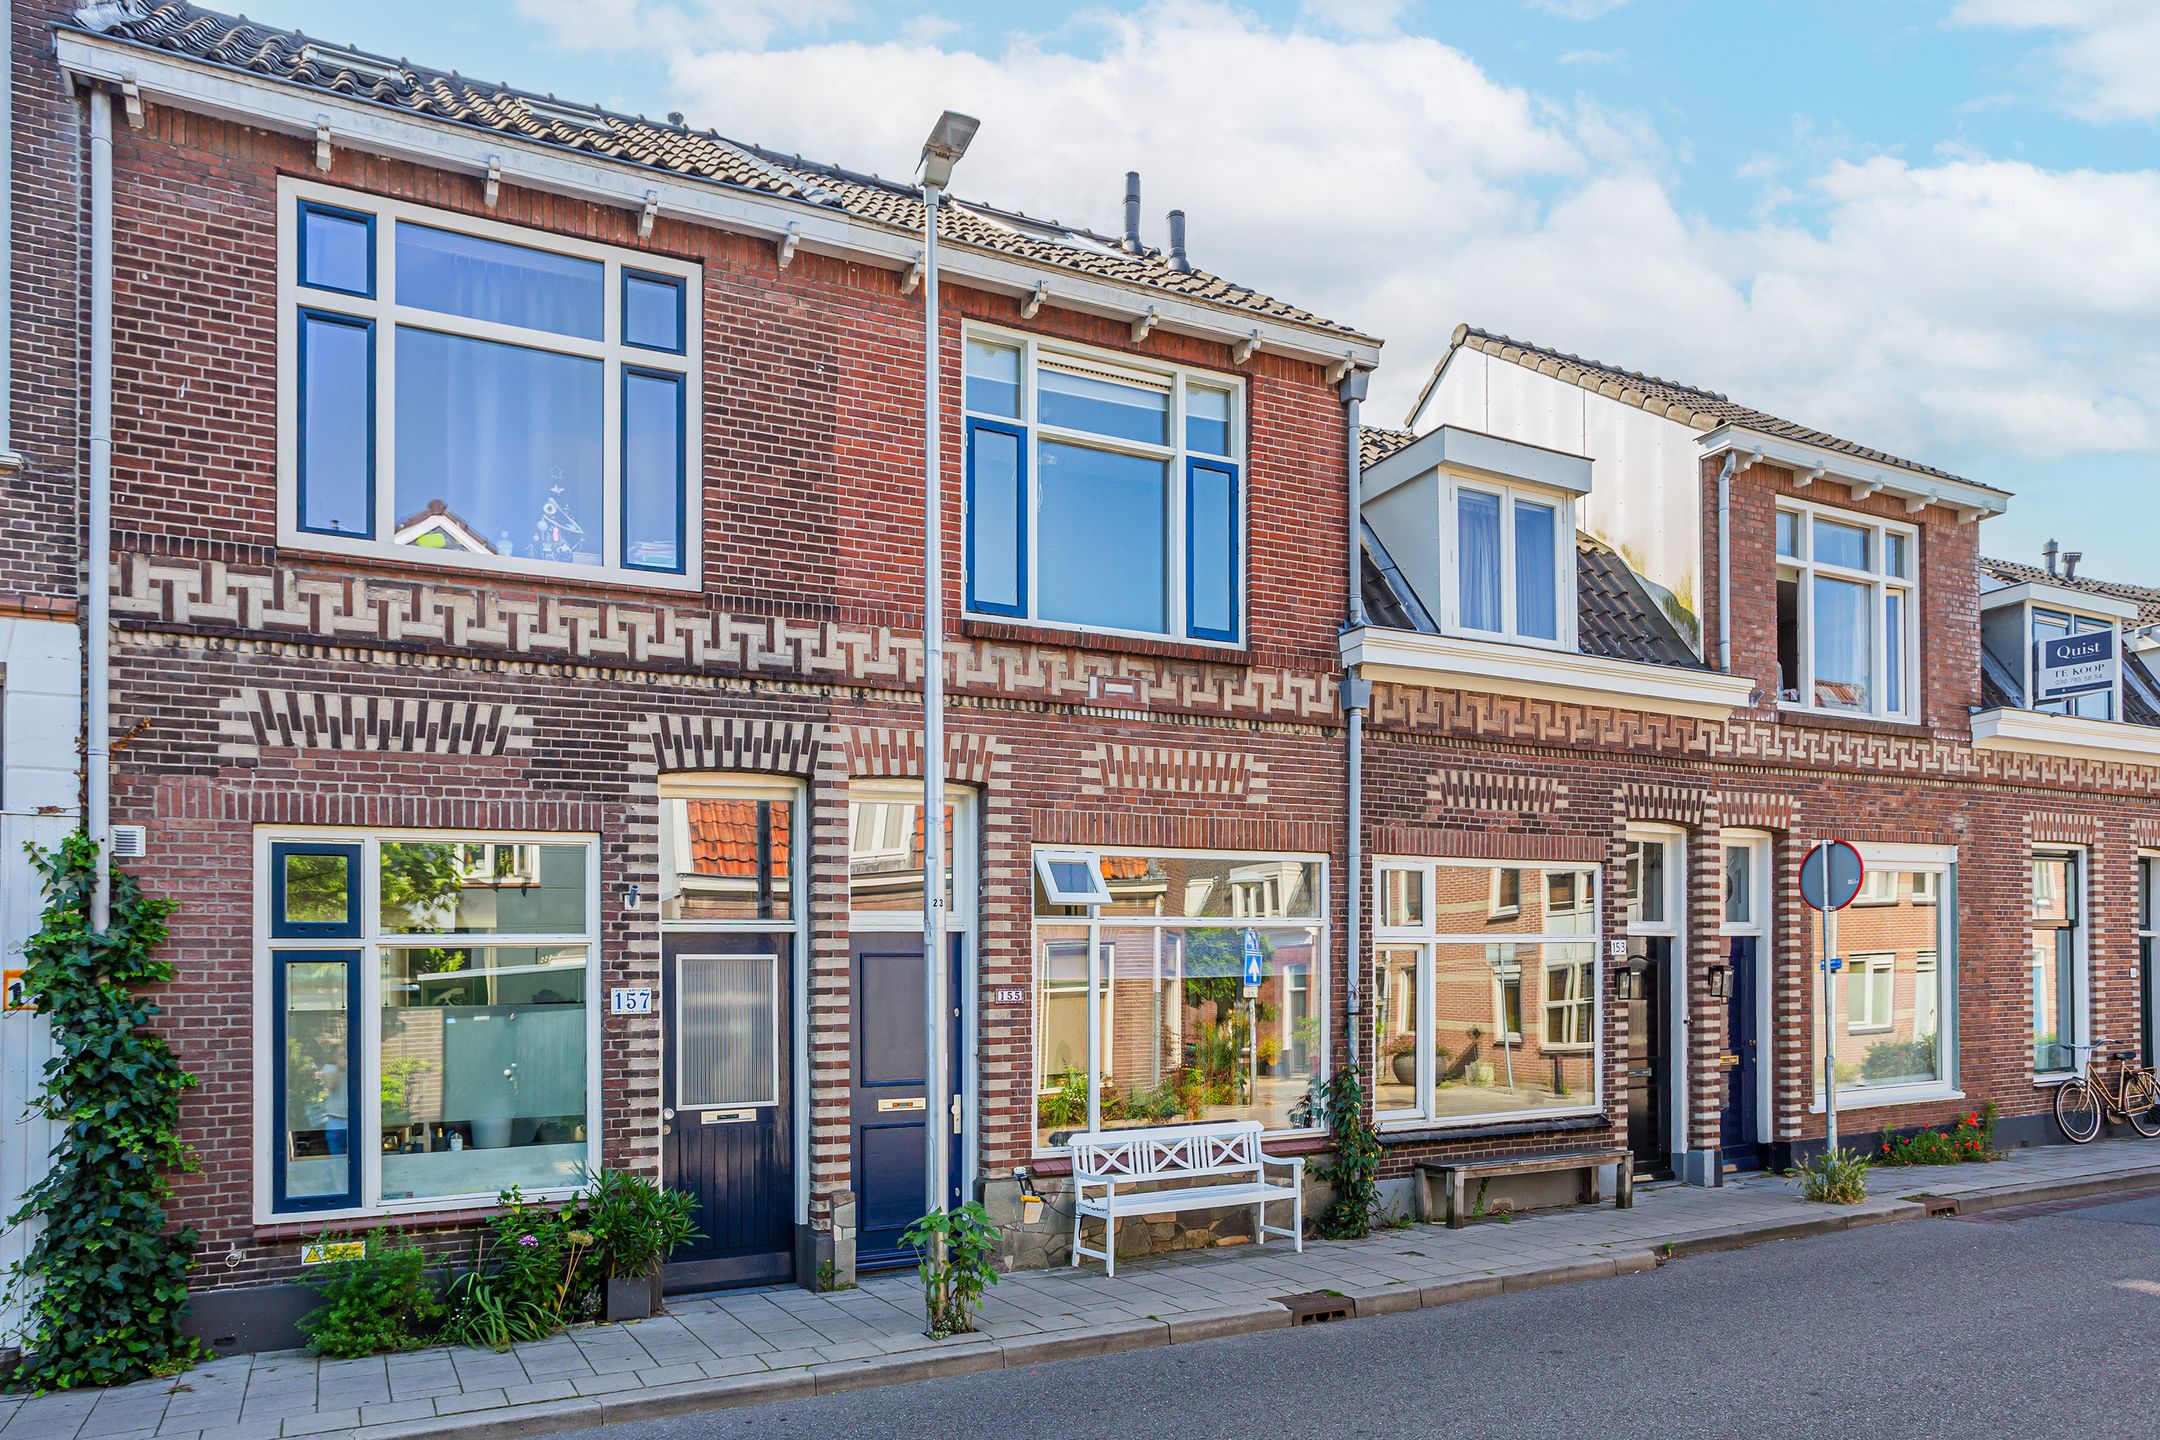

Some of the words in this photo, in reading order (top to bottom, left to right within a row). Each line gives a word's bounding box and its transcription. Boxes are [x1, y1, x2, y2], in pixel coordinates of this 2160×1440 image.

[2056, 642, 2101, 659] Quist
[2054, 669, 2068, 677] TE
[2072, 664, 2104, 675] KOOP
[932, 898, 944, 908] 23
[1612, 941, 1626, 953] 153
[615, 992, 650, 1010] 157
[1000, 991, 1021, 1000] 155
